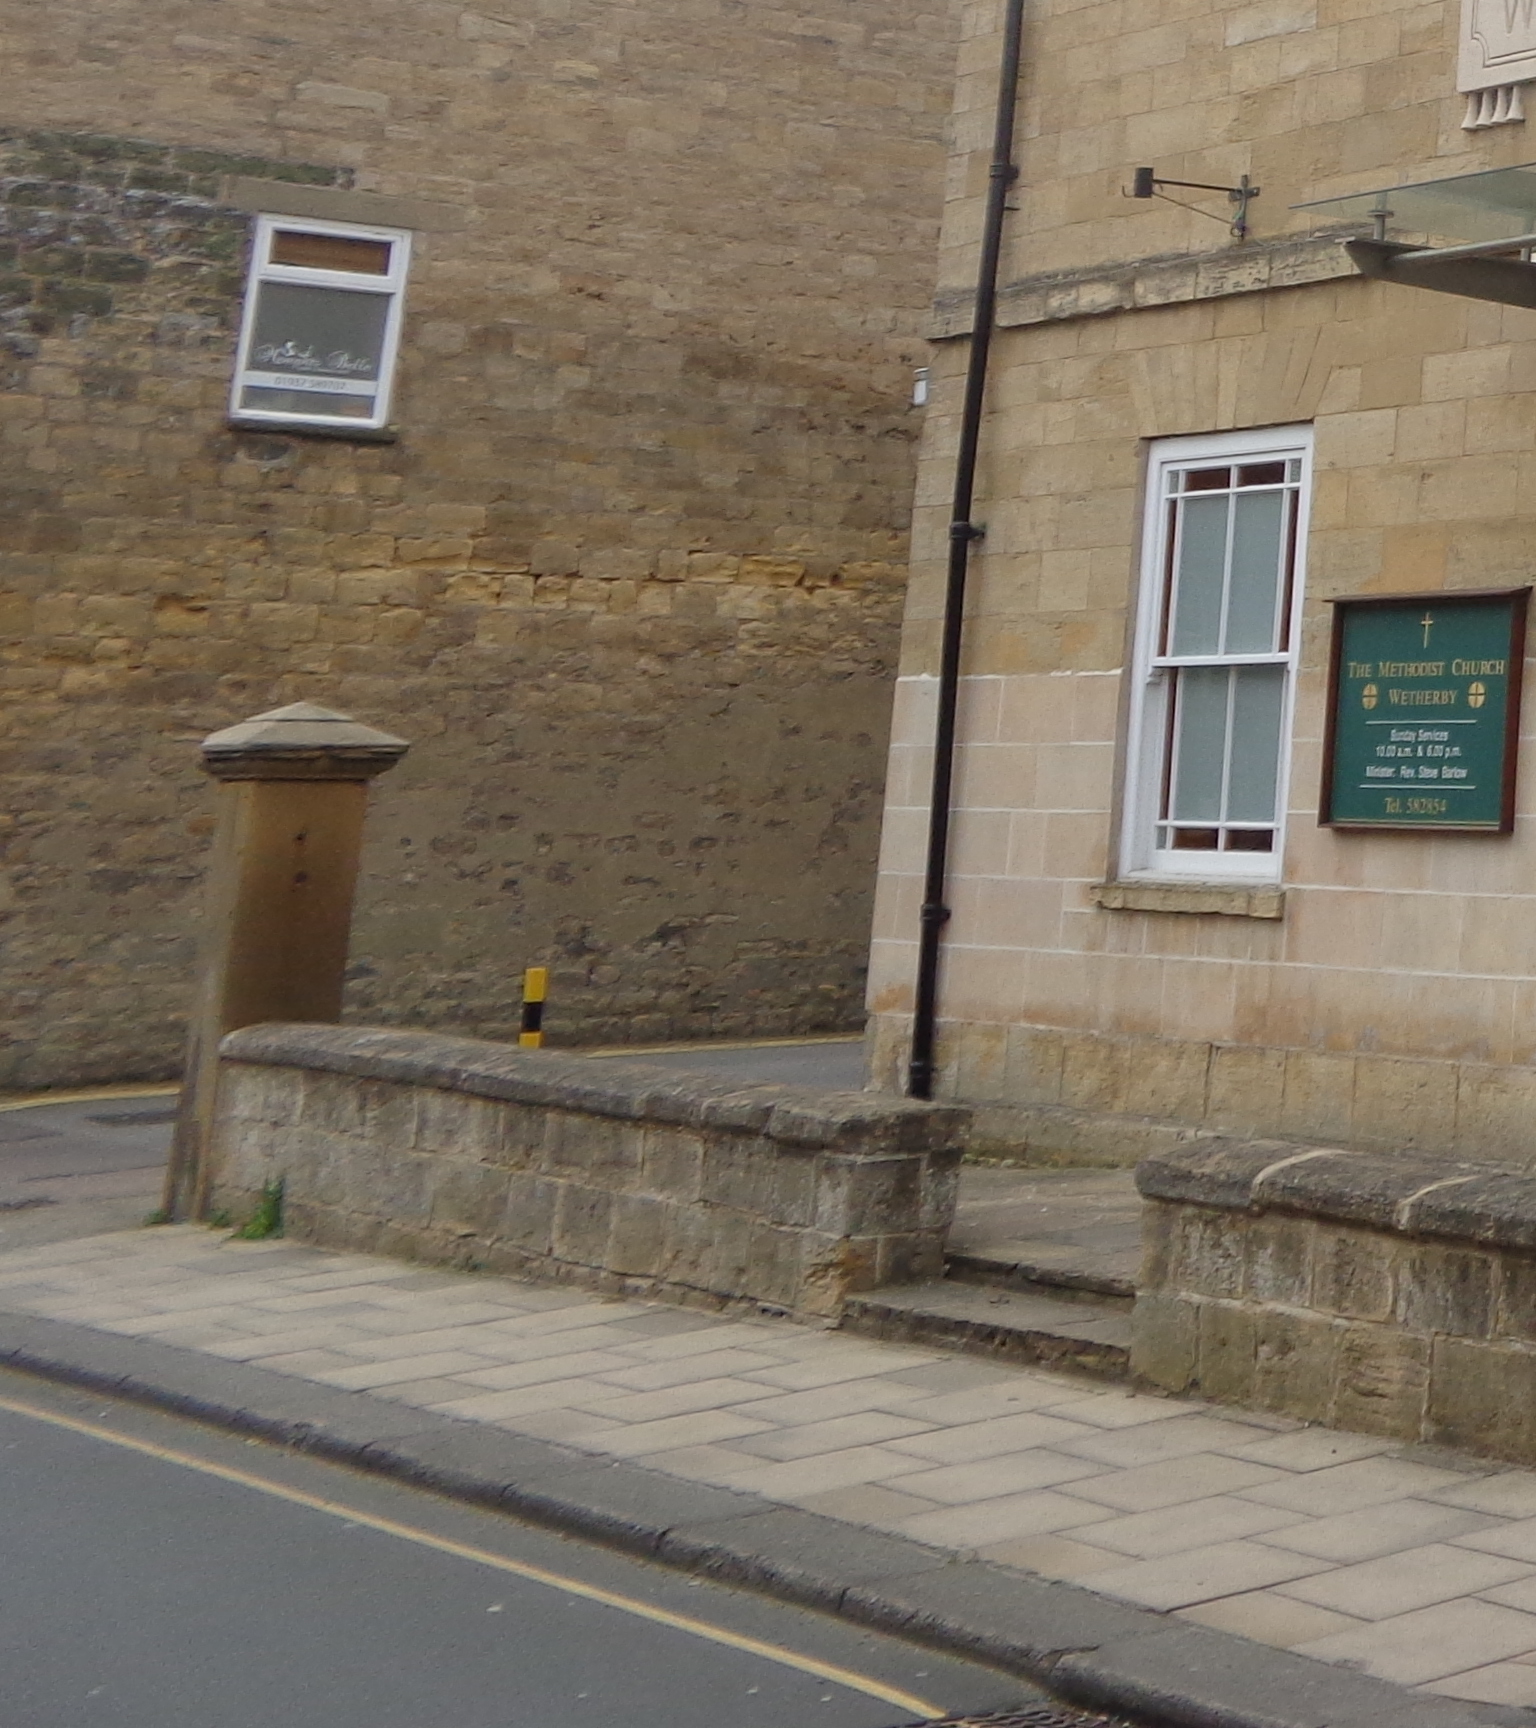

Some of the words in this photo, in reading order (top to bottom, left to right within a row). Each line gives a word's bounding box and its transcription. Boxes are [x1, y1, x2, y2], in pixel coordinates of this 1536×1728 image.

[1347, 661, 1372, 679] THE
[1378, 660, 1446, 678] METHODIST
[1451, 658, 1505, 676] CHURCH
[1388, 688, 1459, 705] WETHERBY
[1390, 729, 1417, 744] Sunday
[1417, 729, 1449, 742] Services
[1416, 745, 1424, 758] &
[1384, 796, 1403, 814] Tel.
